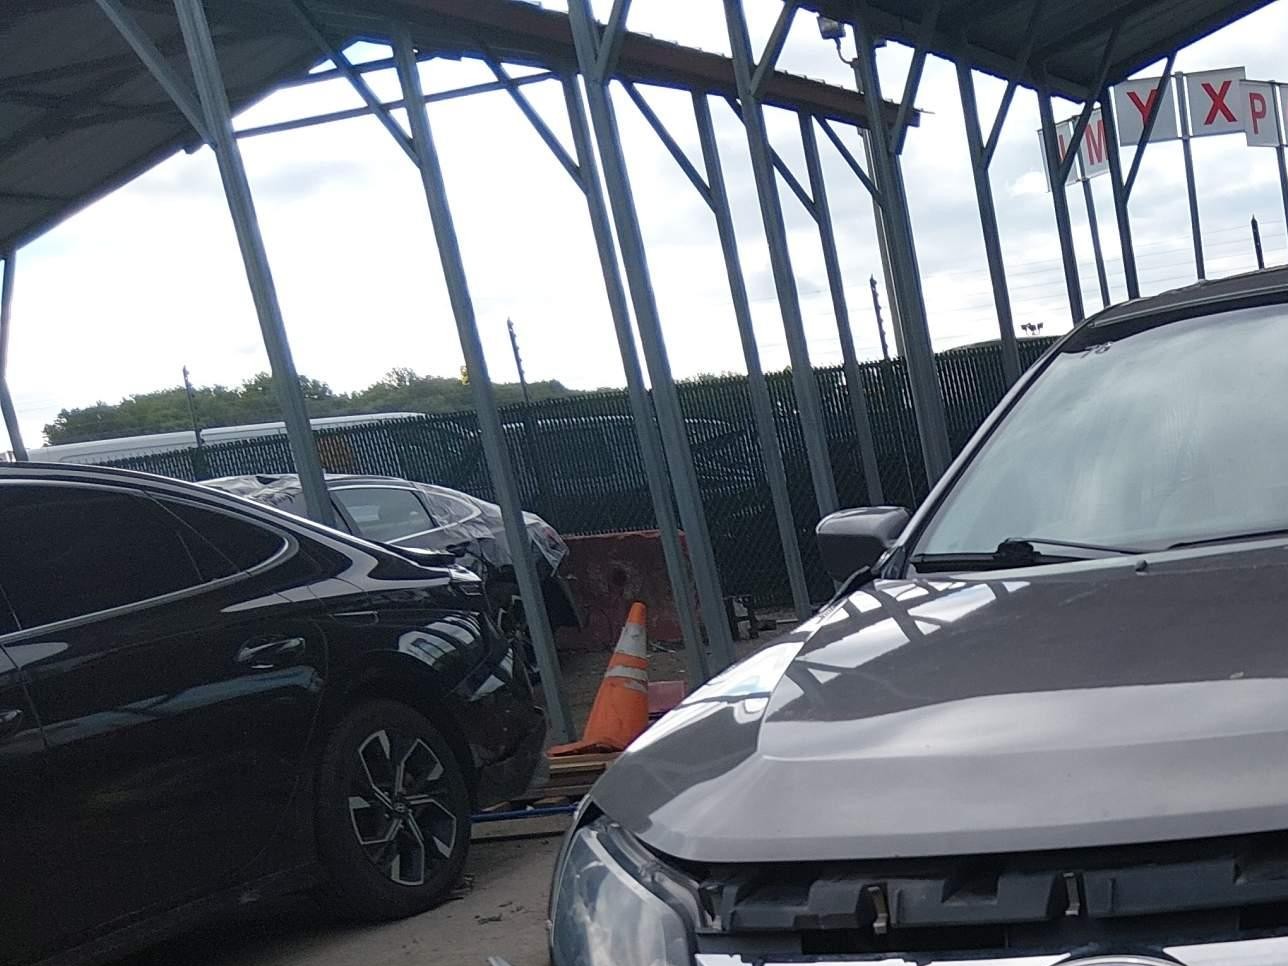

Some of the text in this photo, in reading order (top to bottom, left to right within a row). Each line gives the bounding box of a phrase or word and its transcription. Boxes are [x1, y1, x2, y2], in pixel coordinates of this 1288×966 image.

[1126, 80, 1238, 129] Y X
[1249, 92, 1267, 135] P
